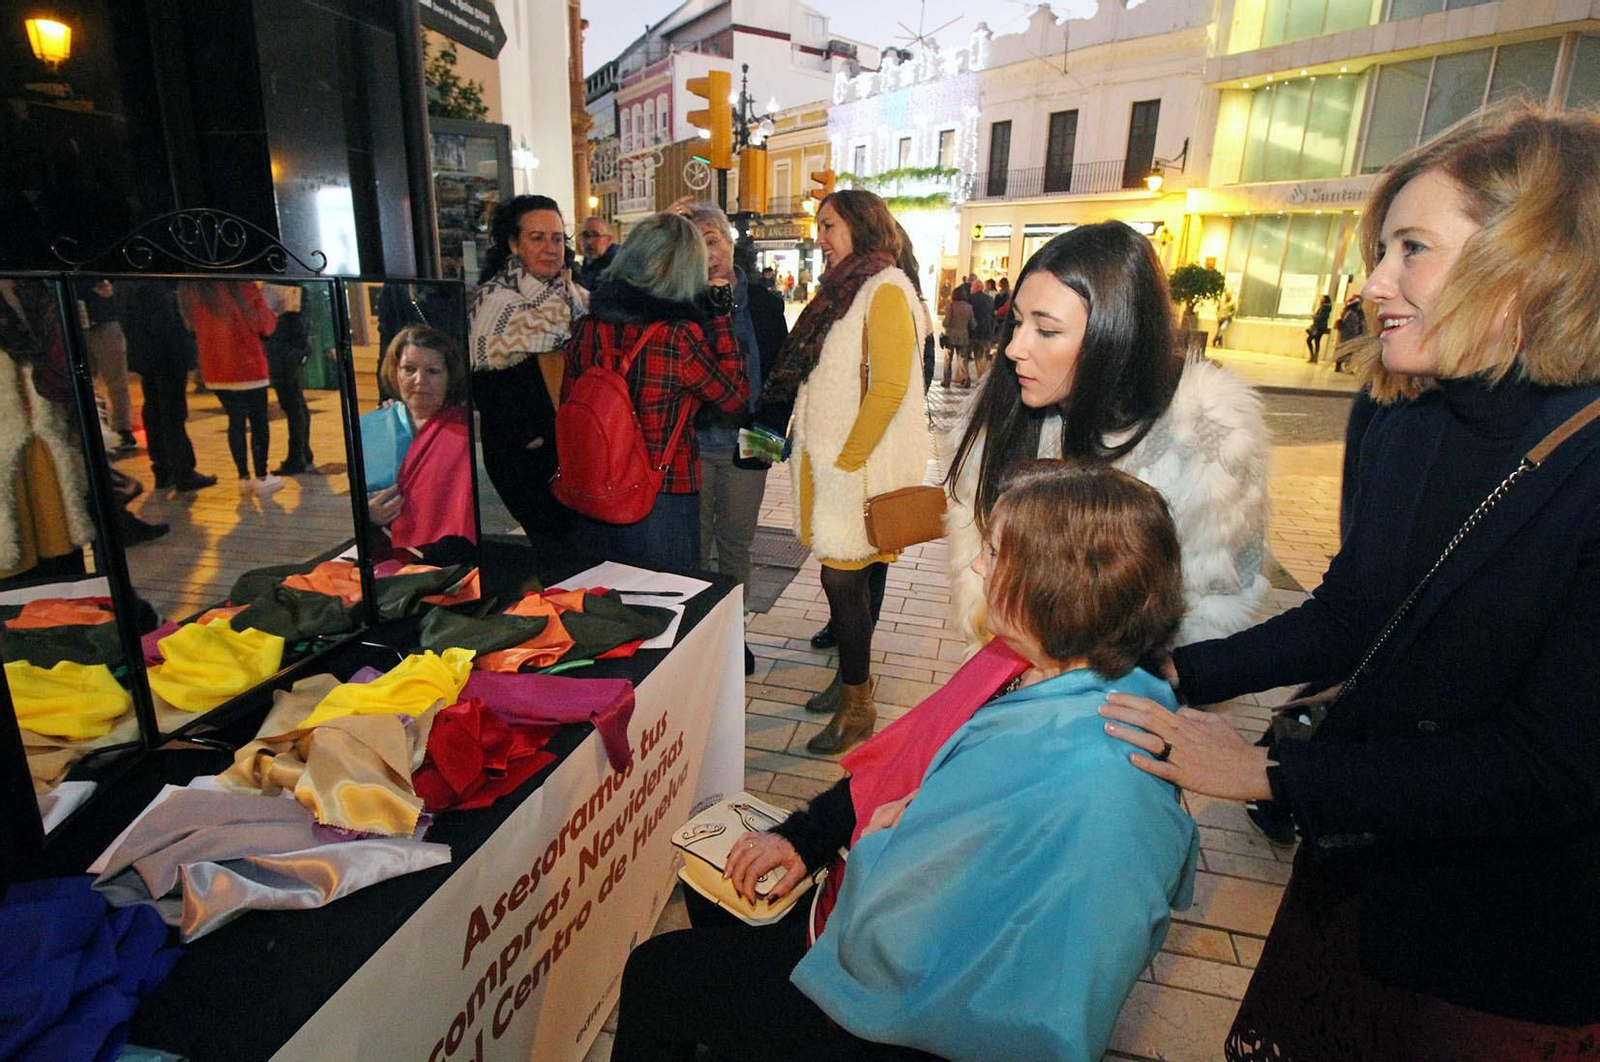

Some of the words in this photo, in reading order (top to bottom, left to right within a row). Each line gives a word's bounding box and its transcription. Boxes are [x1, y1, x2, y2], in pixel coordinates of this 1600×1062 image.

[1310, 187, 1366, 202] Santan
[461, 748, 635, 970] Asesoramos
[640, 710, 668, 761] tus
[469, 1028, 484, 1062] l
[492, 899, 592, 1040] Centro
[598, 861, 627, 904] de
[632, 759, 689, 862] Huelva
[578, 730, 684, 888] Navideñas
